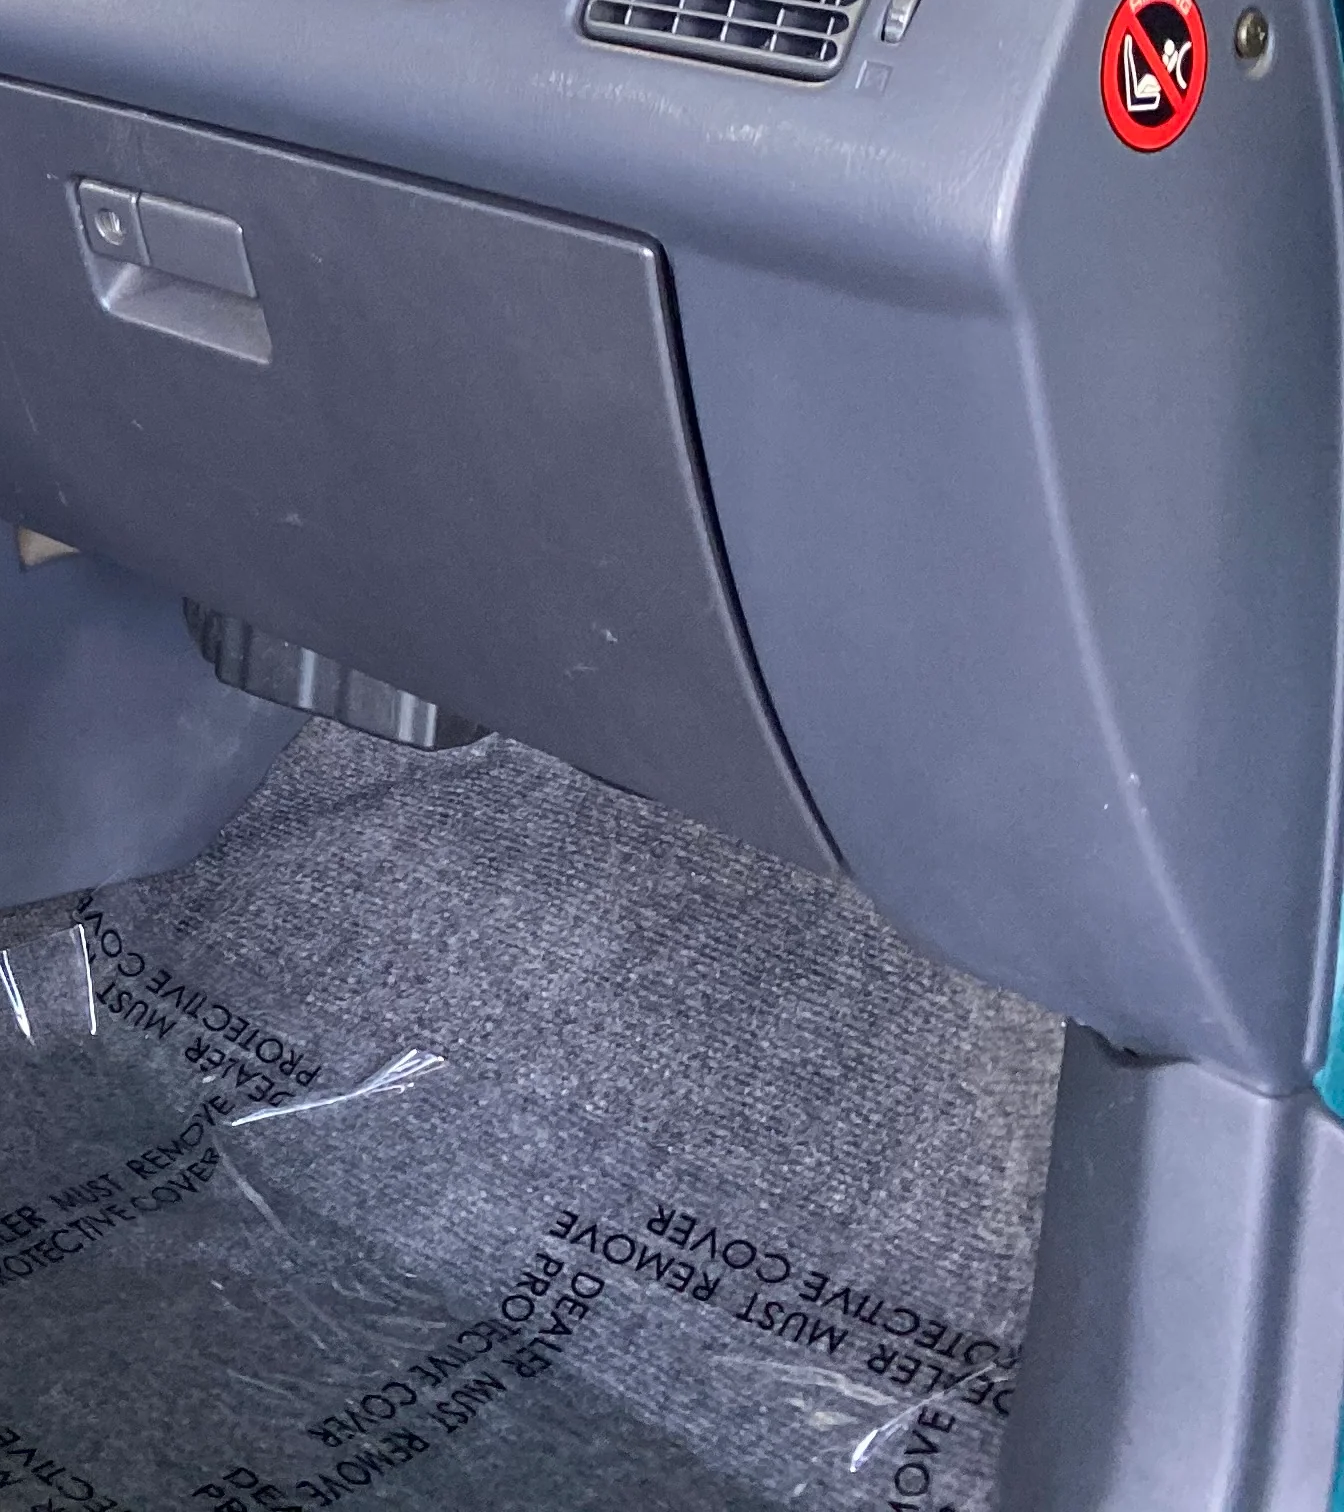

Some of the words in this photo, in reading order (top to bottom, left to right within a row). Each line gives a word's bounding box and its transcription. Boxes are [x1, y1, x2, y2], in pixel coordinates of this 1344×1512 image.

[95, 981, 178, 1039] MUST
[145, 969, 322, 1087] PROTECTIVE
[48, 1172, 123, 1213] MUST
[125, 1094, 236, 1180] REMOVE
[130, 1145, 220, 1214] COVER
[548, 1209, 721, 1303] REMOVE
[646, 1203, 791, 1284] COVER
[409, 1252, 566, 1388] PROTECTIVE
[501, 1271, 606, 1379] DEALER
[735, 1292, 849, 1356] MUST
[307, 1381, 418, 1448] COVER
[428, 1371, 509, 1435] MUST
[296, 1427, 430, 1507] REMOVE
